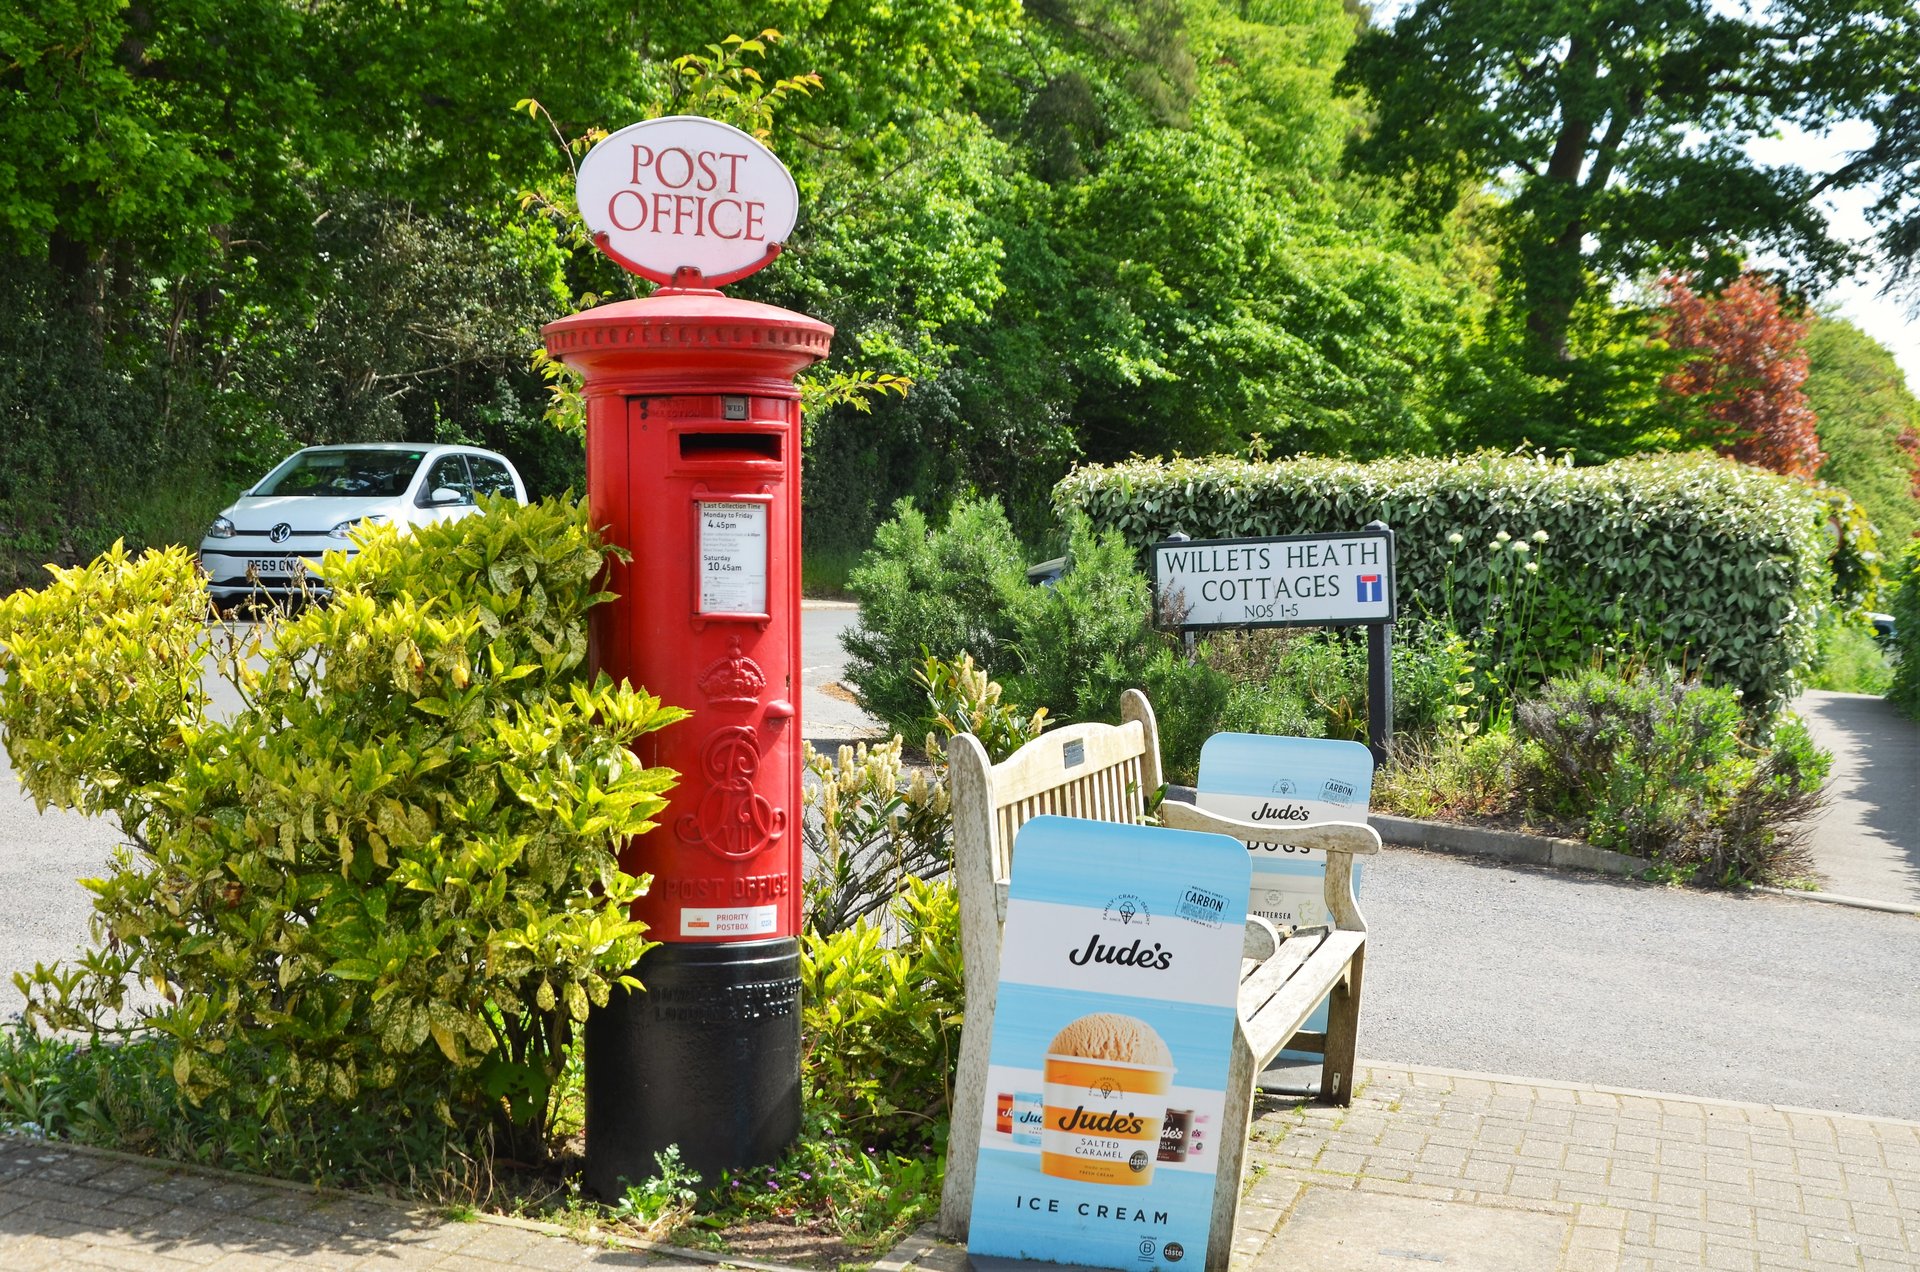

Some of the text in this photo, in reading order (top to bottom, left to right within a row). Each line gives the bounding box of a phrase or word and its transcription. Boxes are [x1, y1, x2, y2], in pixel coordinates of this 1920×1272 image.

[630, 144, 748, 193] POST
[608, 190, 766, 241] OFFICE
[703, 511, 728, 519] Monday
[736, 512, 753, 520] Friday
[708, 520, 737, 529] 4.45pm
[703, 554, 731, 562] Saturday
[1165, 542, 1379, 574] WILLETS HEATH
[708, 562, 742, 571] 10.45am
[1202, 574, 1340, 602] COTTAGES
[1244, 603, 1299, 618] NOS 1-5
[1325, 781, 1353, 796] CARBON
[1251, 802, 1310, 821] Jude's
[663, 872, 789, 901] POST OFFICE
[1185, 890, 1224, 912] CARBON
[716, 913, 749, 921] PRIORITY
[1253, 910, 1291, 920] BATTERSEA
[716, 923, 749, 931] POSTBOX
[1069, 934, 1173, 970] Jude's
[1058, 1106, 1144, 1134] Jude's
[1081, 1138, 1119, 1149] SALTED
[1075, 1147, 1123, 1159] CARAMEL
[1017, 1196, 1168, 1225] ICE CREAM
[1164, 1248, 1183, 1257] taste
